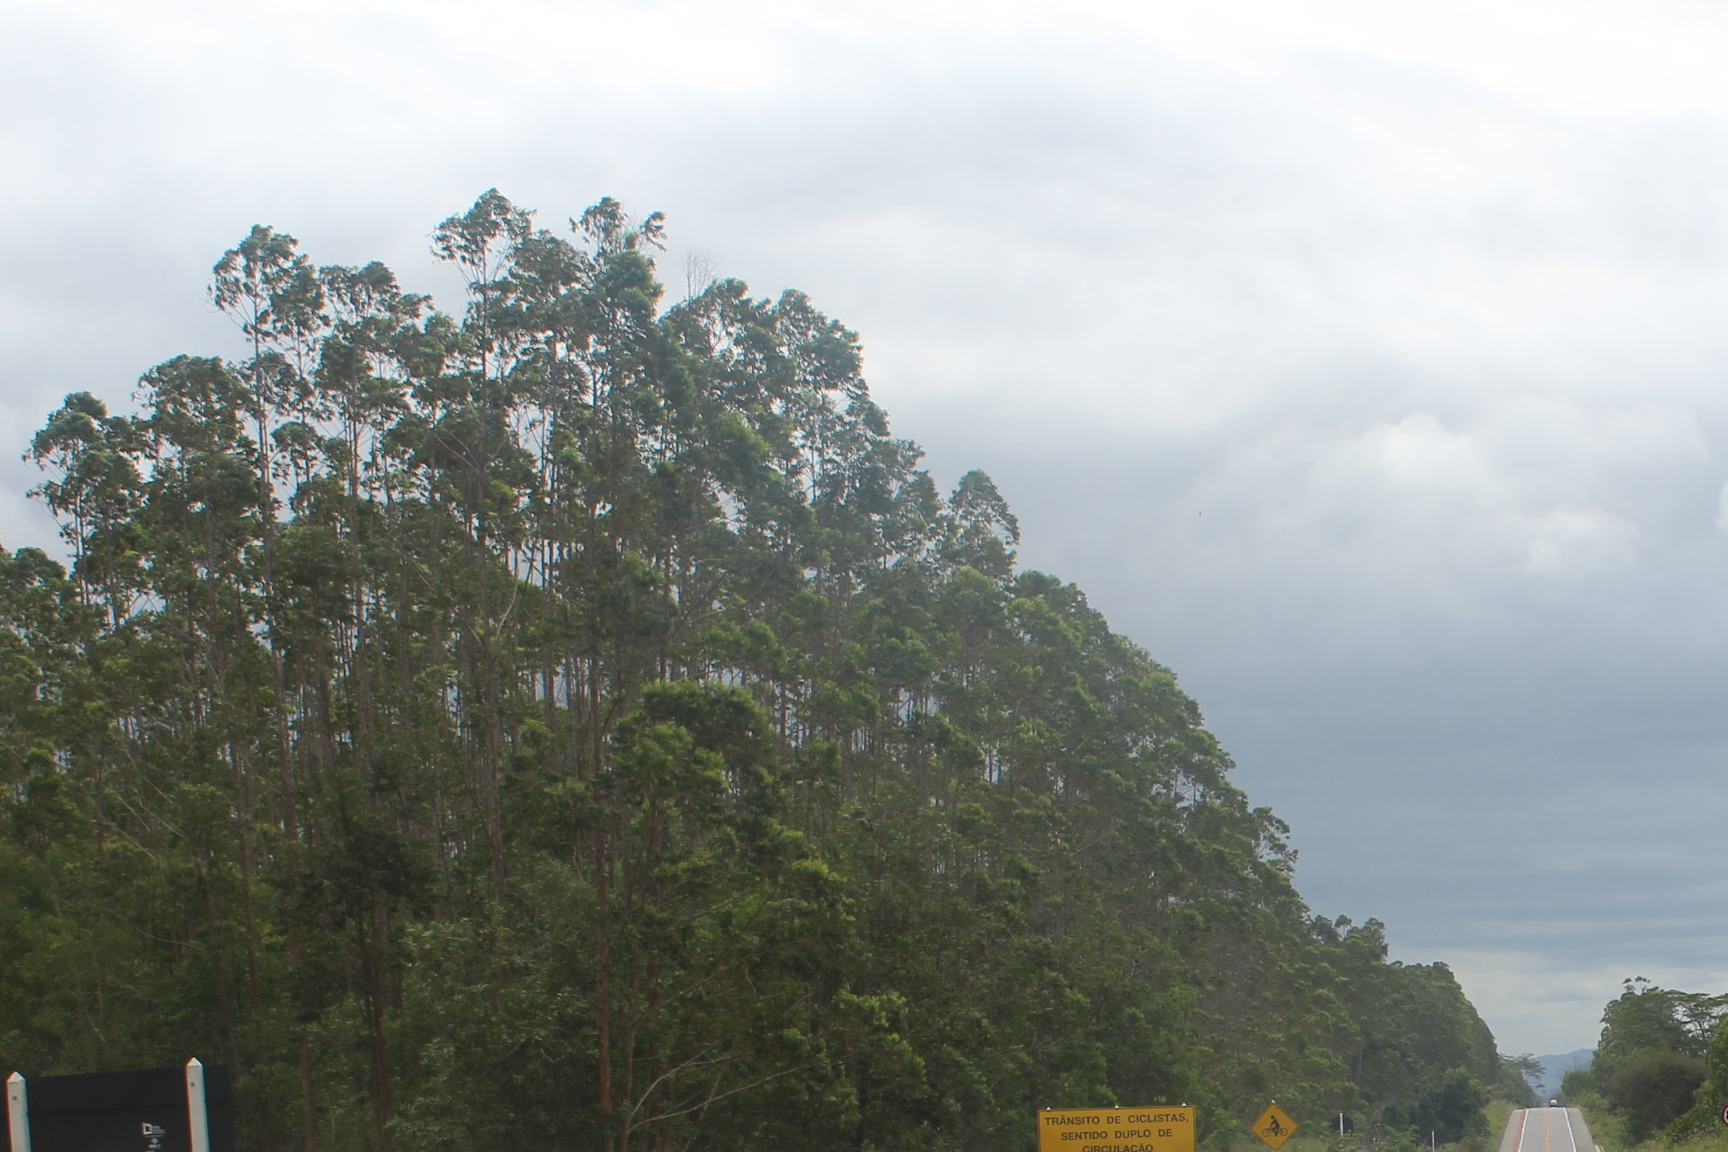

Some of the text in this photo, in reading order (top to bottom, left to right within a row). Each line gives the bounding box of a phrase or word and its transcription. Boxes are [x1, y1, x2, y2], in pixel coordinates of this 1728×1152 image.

[1044, 1113, 1189, 1126] TRÂNSITO DE CICLISTAS,
[1061, 1128, 1173, 1141] SENTIDO DUPLO DE
